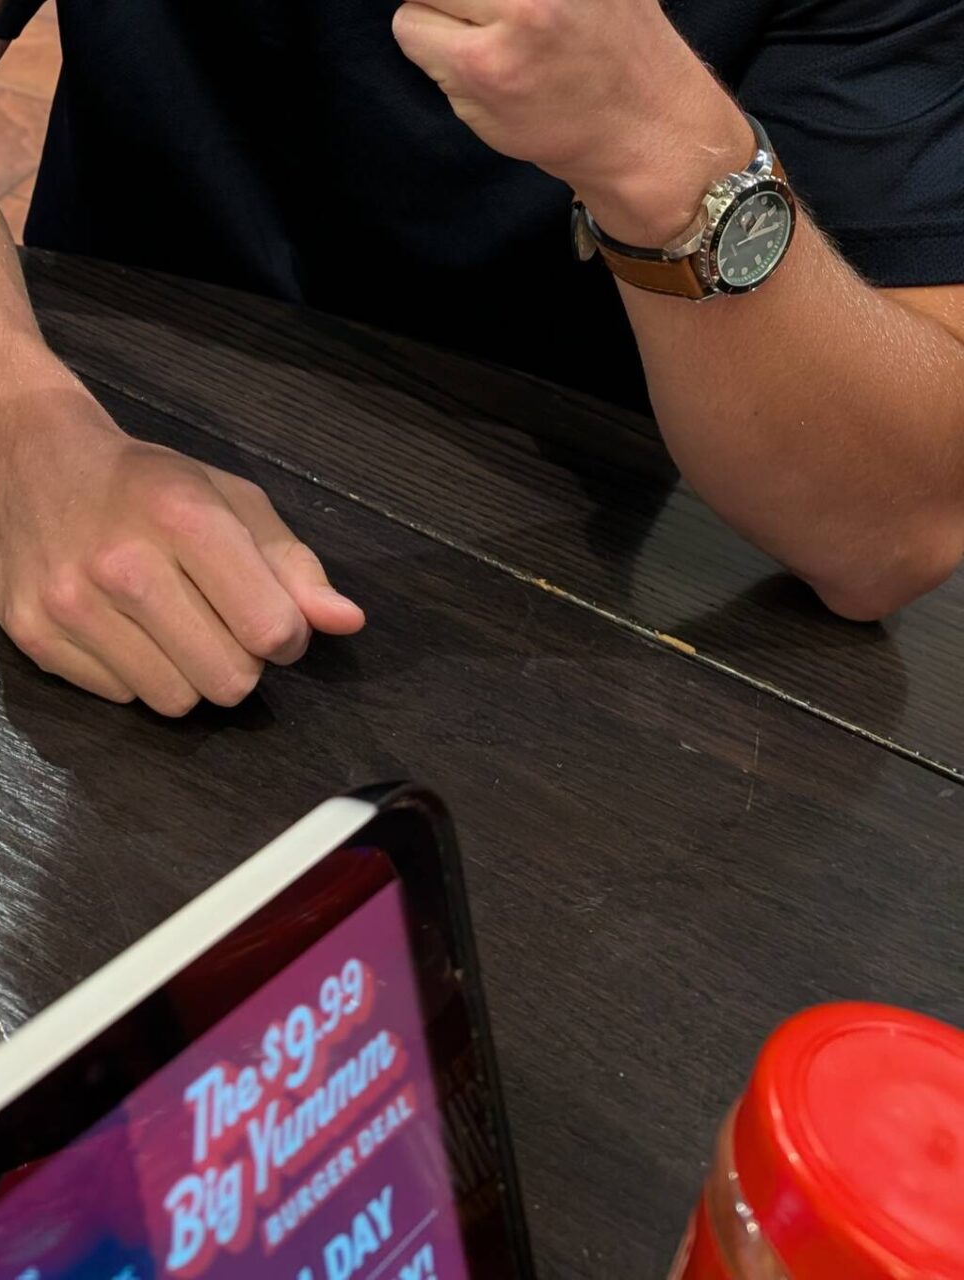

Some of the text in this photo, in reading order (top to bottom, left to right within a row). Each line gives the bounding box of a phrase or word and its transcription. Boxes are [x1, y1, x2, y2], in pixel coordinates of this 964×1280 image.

[184, 958, 365, 1163] The $9.99
[163, 1029, 397, 1272] Big Yummm
[265, 1094, 414, 1247] BURGER DEAL
[322, 1183, 393, 1280] DAY
